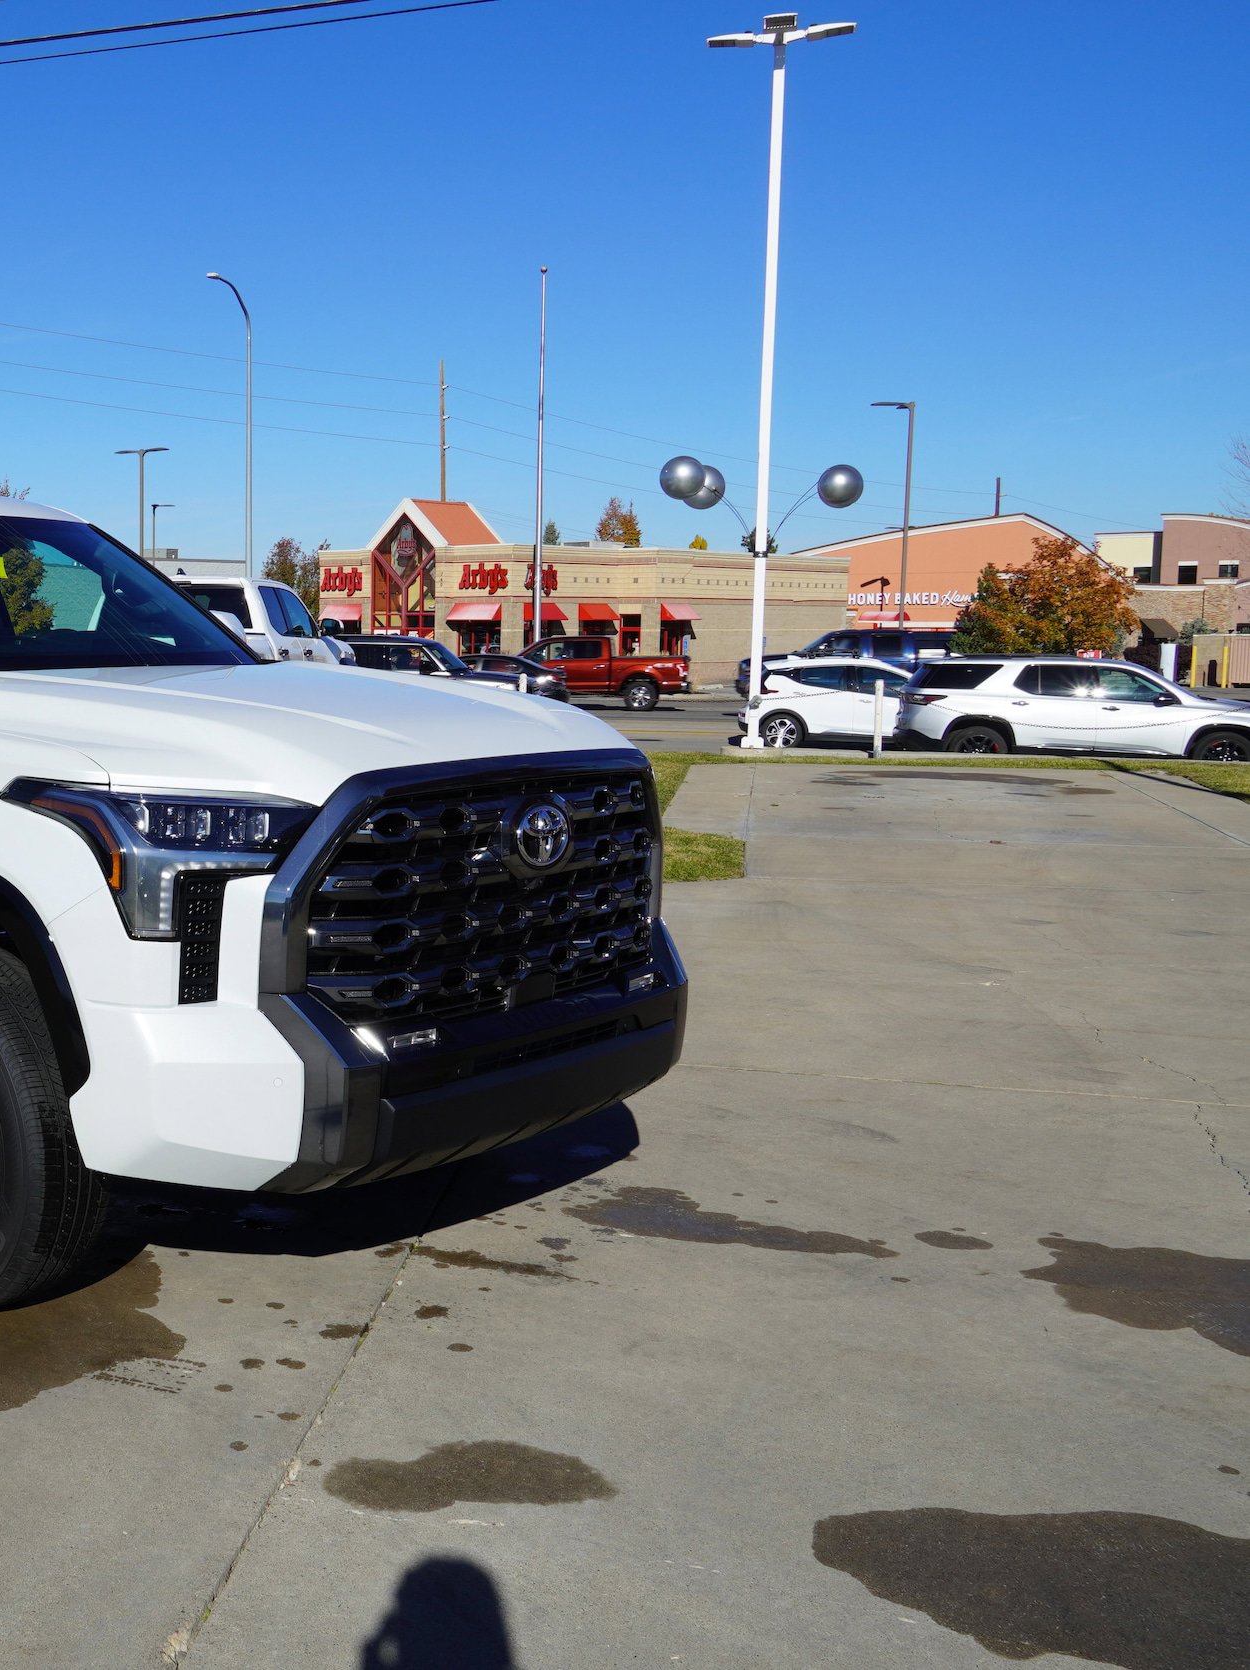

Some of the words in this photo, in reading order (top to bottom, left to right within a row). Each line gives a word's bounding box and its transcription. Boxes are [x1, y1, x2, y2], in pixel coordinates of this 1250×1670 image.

[321, 567, 363, 596] Arby's
[458, 563, 509, 595] Arby's
[848, 592, 891, 606] HONEY
[894, 592, 940, 606] BAKED
